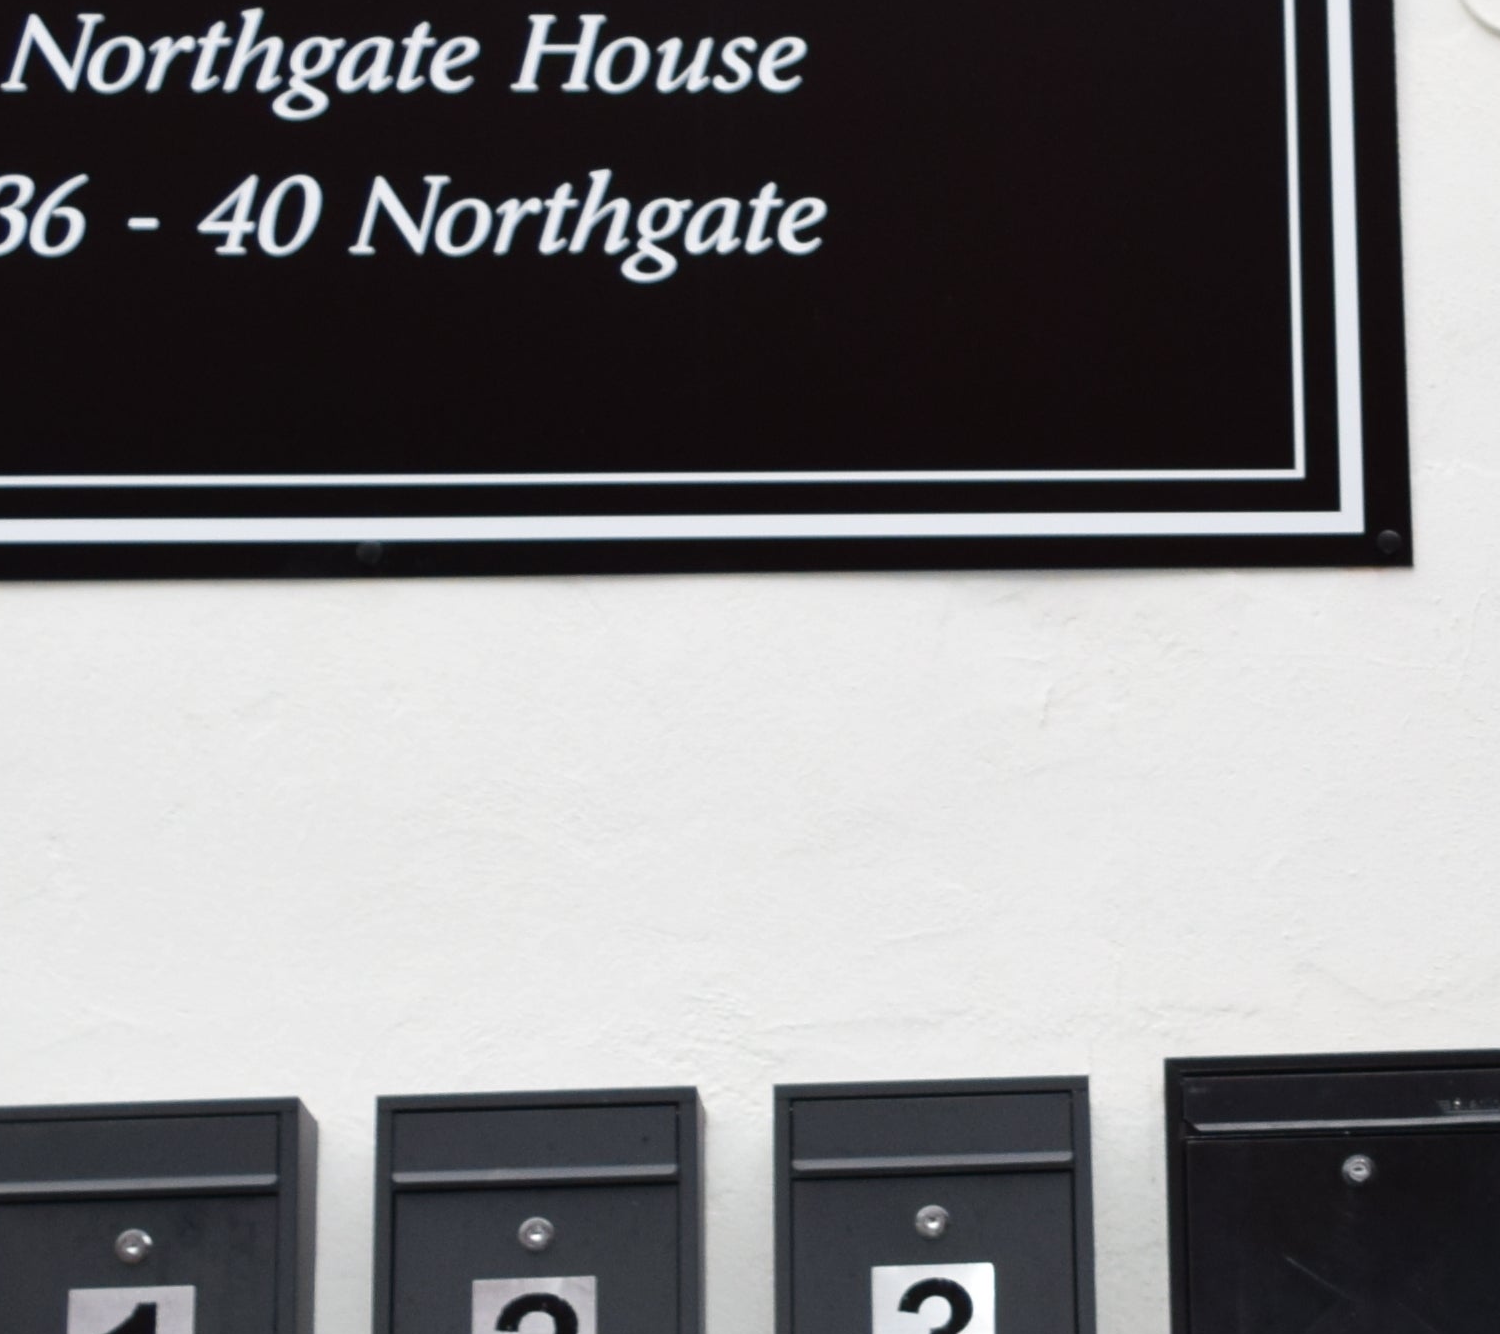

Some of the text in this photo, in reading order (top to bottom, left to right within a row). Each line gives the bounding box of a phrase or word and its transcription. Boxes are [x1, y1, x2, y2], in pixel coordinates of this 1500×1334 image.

[0, 6, 809, 122] Northgate House
[196, 173, 324, 258] 40
[347, 167, 828, 284] Northgate
